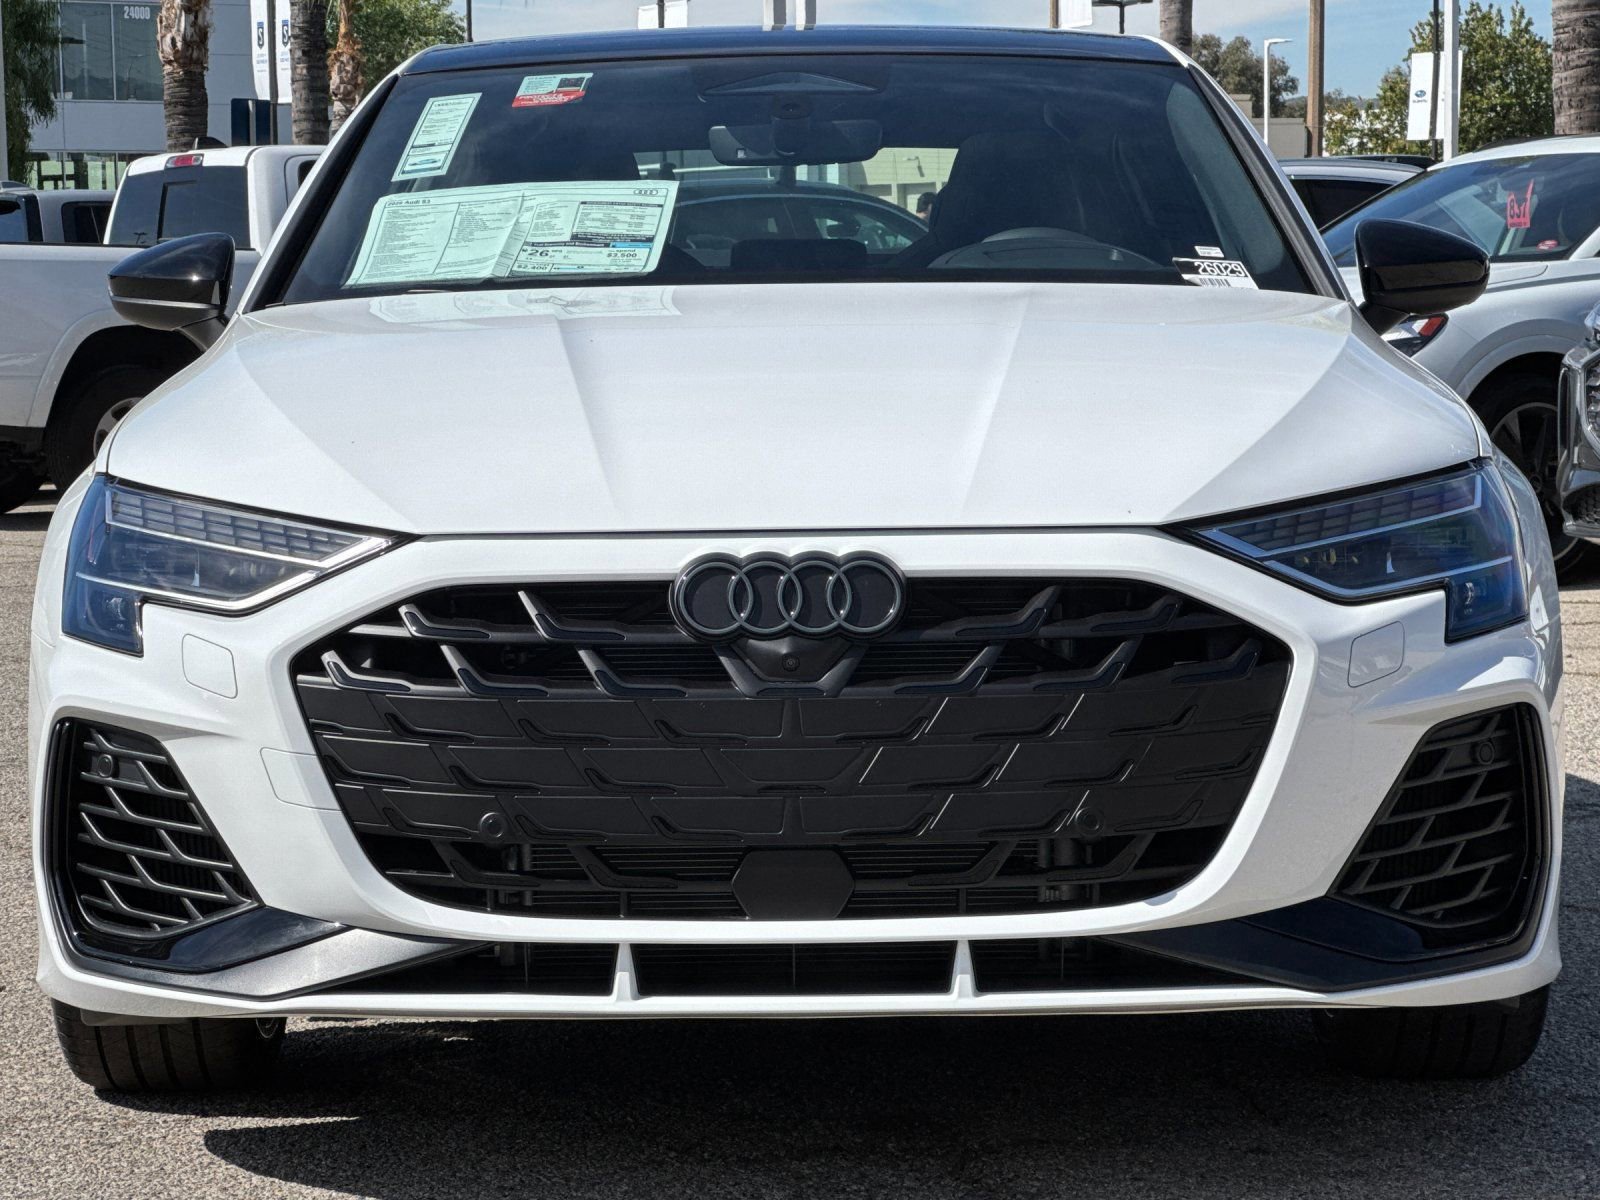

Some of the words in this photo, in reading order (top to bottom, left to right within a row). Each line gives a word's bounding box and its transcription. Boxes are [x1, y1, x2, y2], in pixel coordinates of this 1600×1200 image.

[123, 5, 151, 20] 24000
[528, 248, 550, 257] 26
[1194, 261, 1246, 277] 26029
